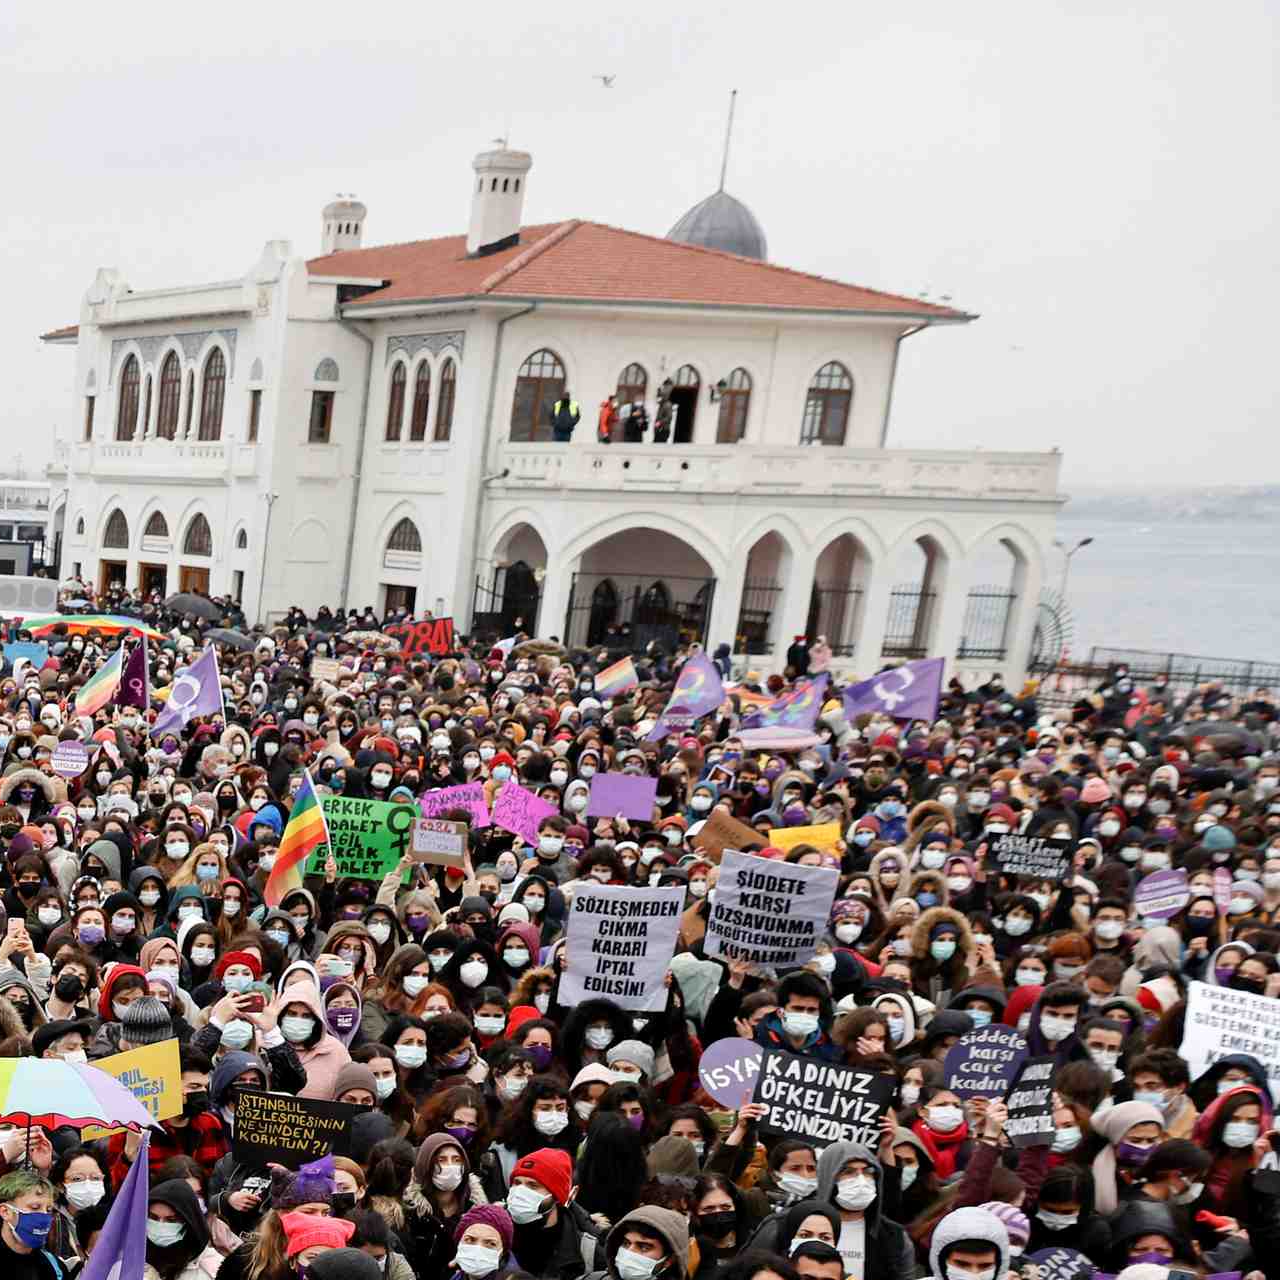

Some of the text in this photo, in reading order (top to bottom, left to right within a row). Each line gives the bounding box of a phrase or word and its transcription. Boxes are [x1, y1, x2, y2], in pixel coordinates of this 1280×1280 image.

[323, 799, 374, 816] ERKEK
[737, 869, 807, 895] ŞİDDETE
[575, 895, 679, 921] SÖZLEŞMEDEN
[739, 893, 791, 916] KARŞI
[597, 920, 647, 940] ÇIKMA
[714, 905, 815, 936] ÖZSAVUNMA
[591, 938, 646, 957] KARARI
[595, 955, 635, 977] İPTAL
[583, 974, 645, 998] EDİLSİN!
[701, 1058, 762, 1091] İSYA
[765, 1054, 876, 1093] KADINIZ
[238, 1093, 308, 1115] İSTANBUL
[761, 1077, 884, 1126] ÖFKELİYİZ
[239, 1131, 310, 1151] KORKTUN
